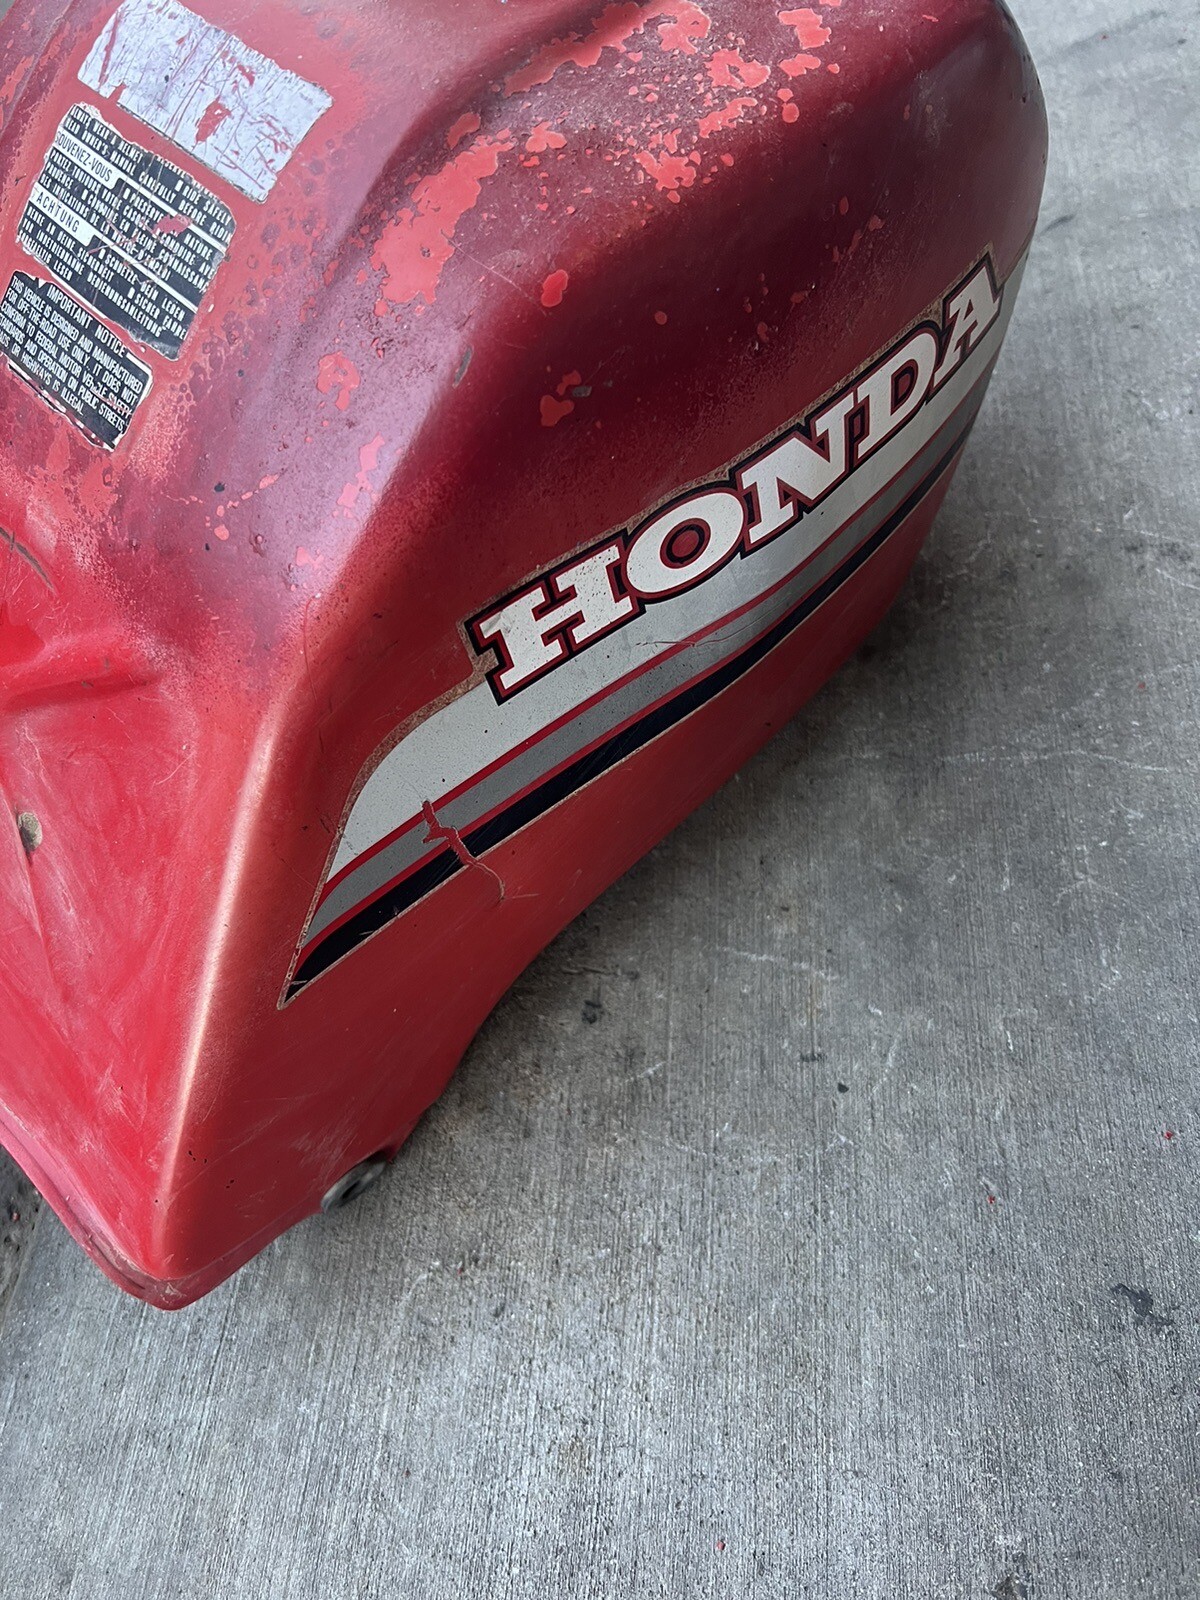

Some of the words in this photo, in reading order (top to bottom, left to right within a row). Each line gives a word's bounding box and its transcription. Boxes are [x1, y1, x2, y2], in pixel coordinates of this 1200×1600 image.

[53, 130, 113, 183] SOUVENEZ-VOUS
[80, 128, 109, 156] OWNER'S
[109, 149, 137, 176] MANUAL
[137, 169, 177, 205] CAREFULLY
[177, 198, 207, 227] BEFORE
[92, 120, 110, 140] WEAR
[109, 133, 117, 145] A
[117, 138, 143, 164] HELMET
[181, 183, 201, 205] RIDE
[202, 198, 232, 227] SAFELY
[35, 190, 80, 232] ACHTUNG
[39, 172, 52, 189] DES
[89, 210, 100, 227] DE
[99, 218, 111, 235] LA
[44, 160, 74, 190] PRUDENCE
[118, 217, 131, 233] EN
[49, 148, 72, 172] PORTEZ
[70, 164, 102, 195] TOUJOURS
[100, 187, 123, 211] VOTRE
[158, 231, 196, 266] CONDUIRE
[26, 205, 45, 227] DENKE
[45, 220, 56, 236] AN
[56, 229, 76, 252] DEINE
[75, 246, 114, 283] SICHERHEIT
[133, 292, 161, 320] SICHER
[52, 258, 73, 282] LESEN
[183, 232, 213, 261] NATURE
[46, 283, 93, 330] IMPORTANT
[94, 323, 127, 358] NOTICE
[104, 252, 138, 285] SCHUETZE
[139, 279, 159, 302] DEIN
[160, 295, 186, 323] LEBEN
[0, 299, 27, 329] CONFORM
[24, 321, 36, 338] TO
[33, 329, 61, 359] FEDERAL
[57, 350, 82, 378] MOTOR
[4, 286, 19, 305] FOR
[16, 297, 58, 339] OFF-THE-ROAD
[56, 332, 72, 352] USE
[91, 362, 102, 378] IT
[101, 369, 122, 394] DOES
[120, 385, 138, 407] NOT
[9, 275, 25, 294] THIS
[21, 285, 46, 312] VEHICLE
[42, 303, 52, 319] IS
[49, 309, 80, 342] DESIGNED
[76, 332, 94, 354] AND
[91, 345, 143, 395] MANUFACTURED
[10, 341, 22, 357] OR
[19, 350, 53, 386] HIGHWAYS
[51, 378, 61, 393] IS
[23, 337, 39, 357] AND
[36, 348, 68, 383] OPERATION
[66, 374, 79, 392] ON
[76, 383, 100, 410] PUBLIC
[475, 261, 1001, 697] HONDA
